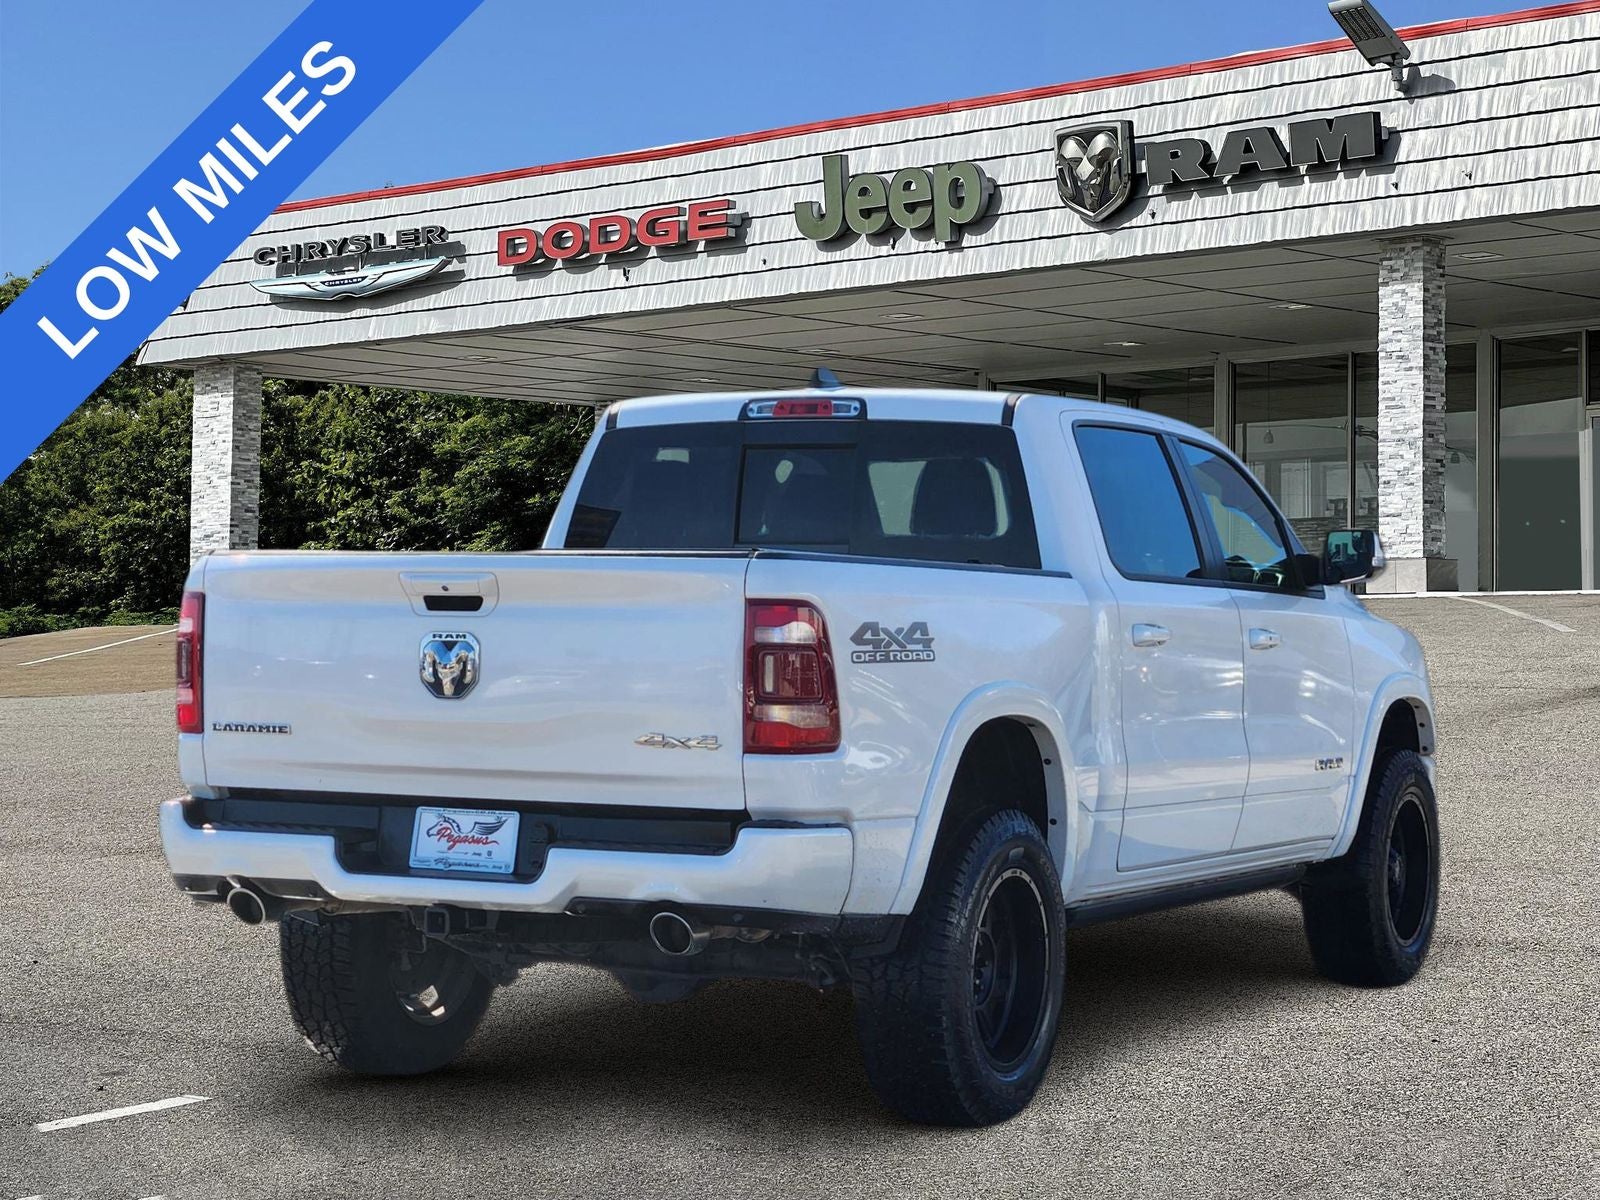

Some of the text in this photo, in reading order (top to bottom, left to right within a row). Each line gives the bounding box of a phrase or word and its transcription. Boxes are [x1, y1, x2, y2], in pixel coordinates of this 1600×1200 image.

[1145, 111, 1381, 186] RAM
[794, 154, 989, 242] Jeep
[253, 225, 448, 266] CHRYSLER
[498, 199, 736, 267] DODGE
[324, 276, 364, 286] CHRYSLER
[852, 650, 934, 663] OFF ROAD
[212, 722, 289, 734] LARAMIE
[436, 826, 500, 851] Pegasus
